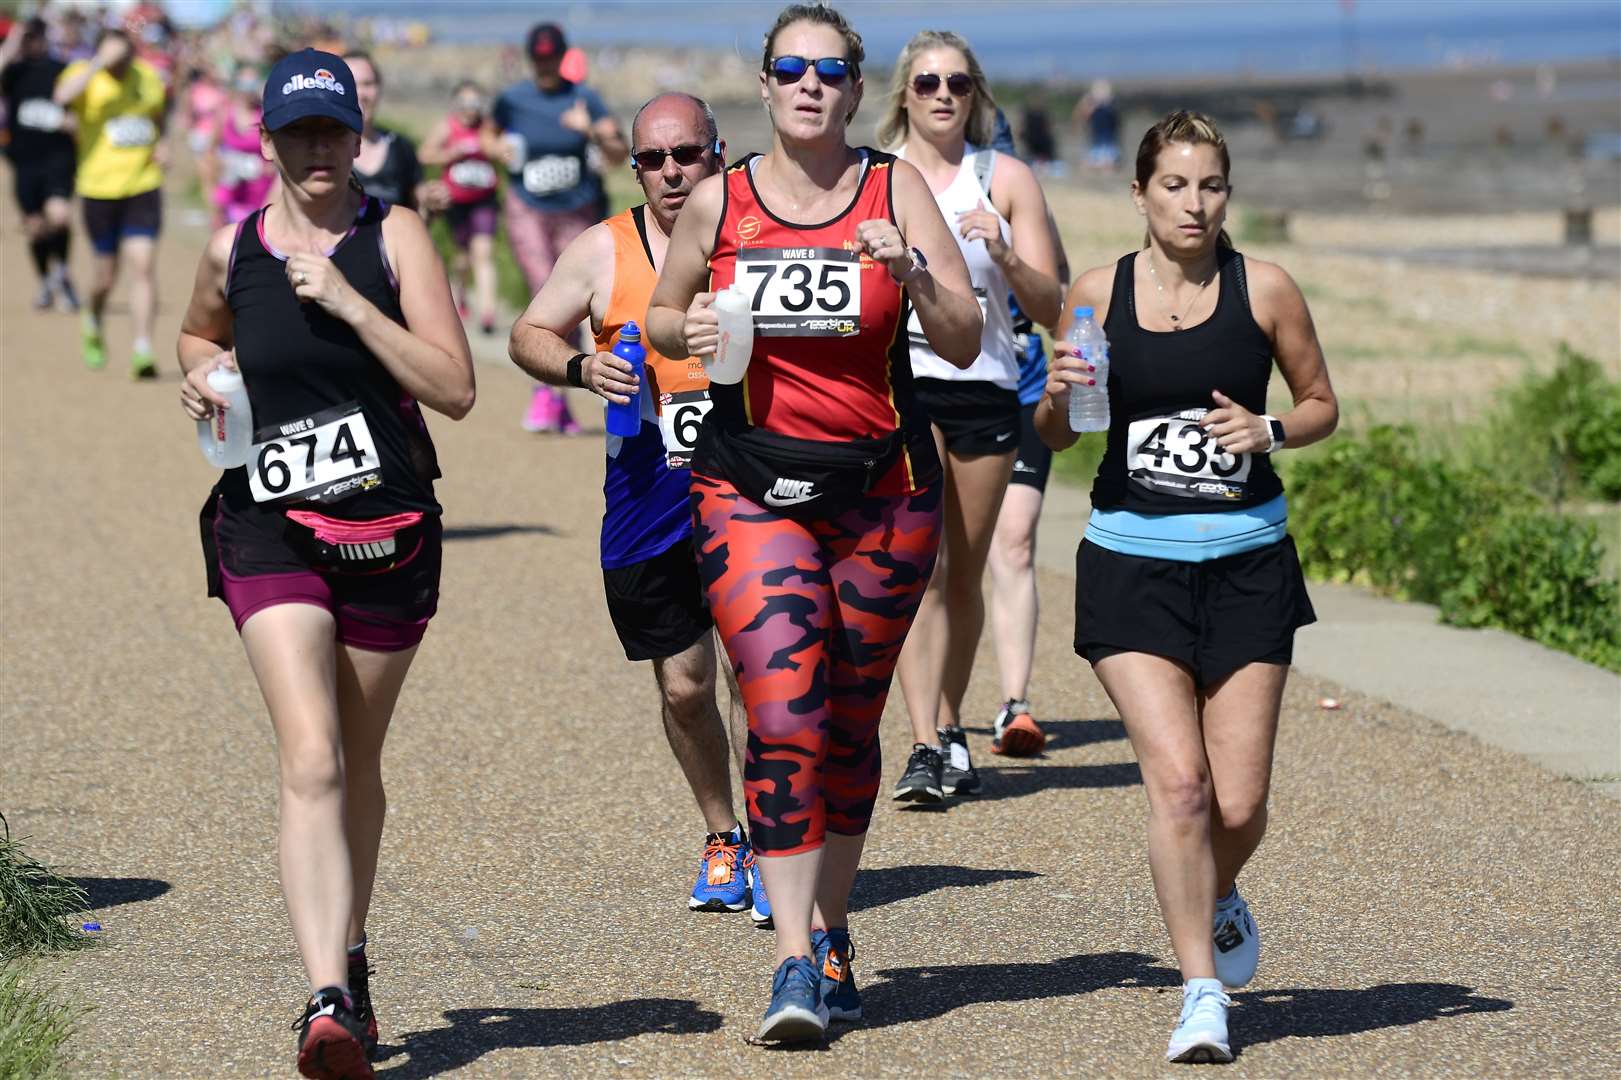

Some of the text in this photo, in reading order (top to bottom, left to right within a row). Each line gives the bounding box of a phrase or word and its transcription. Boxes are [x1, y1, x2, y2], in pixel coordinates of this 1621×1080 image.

[282, 74, 345, 95] ellesse
[782, 248, 807, 259] WAVE
[746, 264, 851, 312] 735
[280, 418, 314, 436] WAVE 9
[257, 422, 366, 494] 674
[772, 477, 814, 498] NIKE
